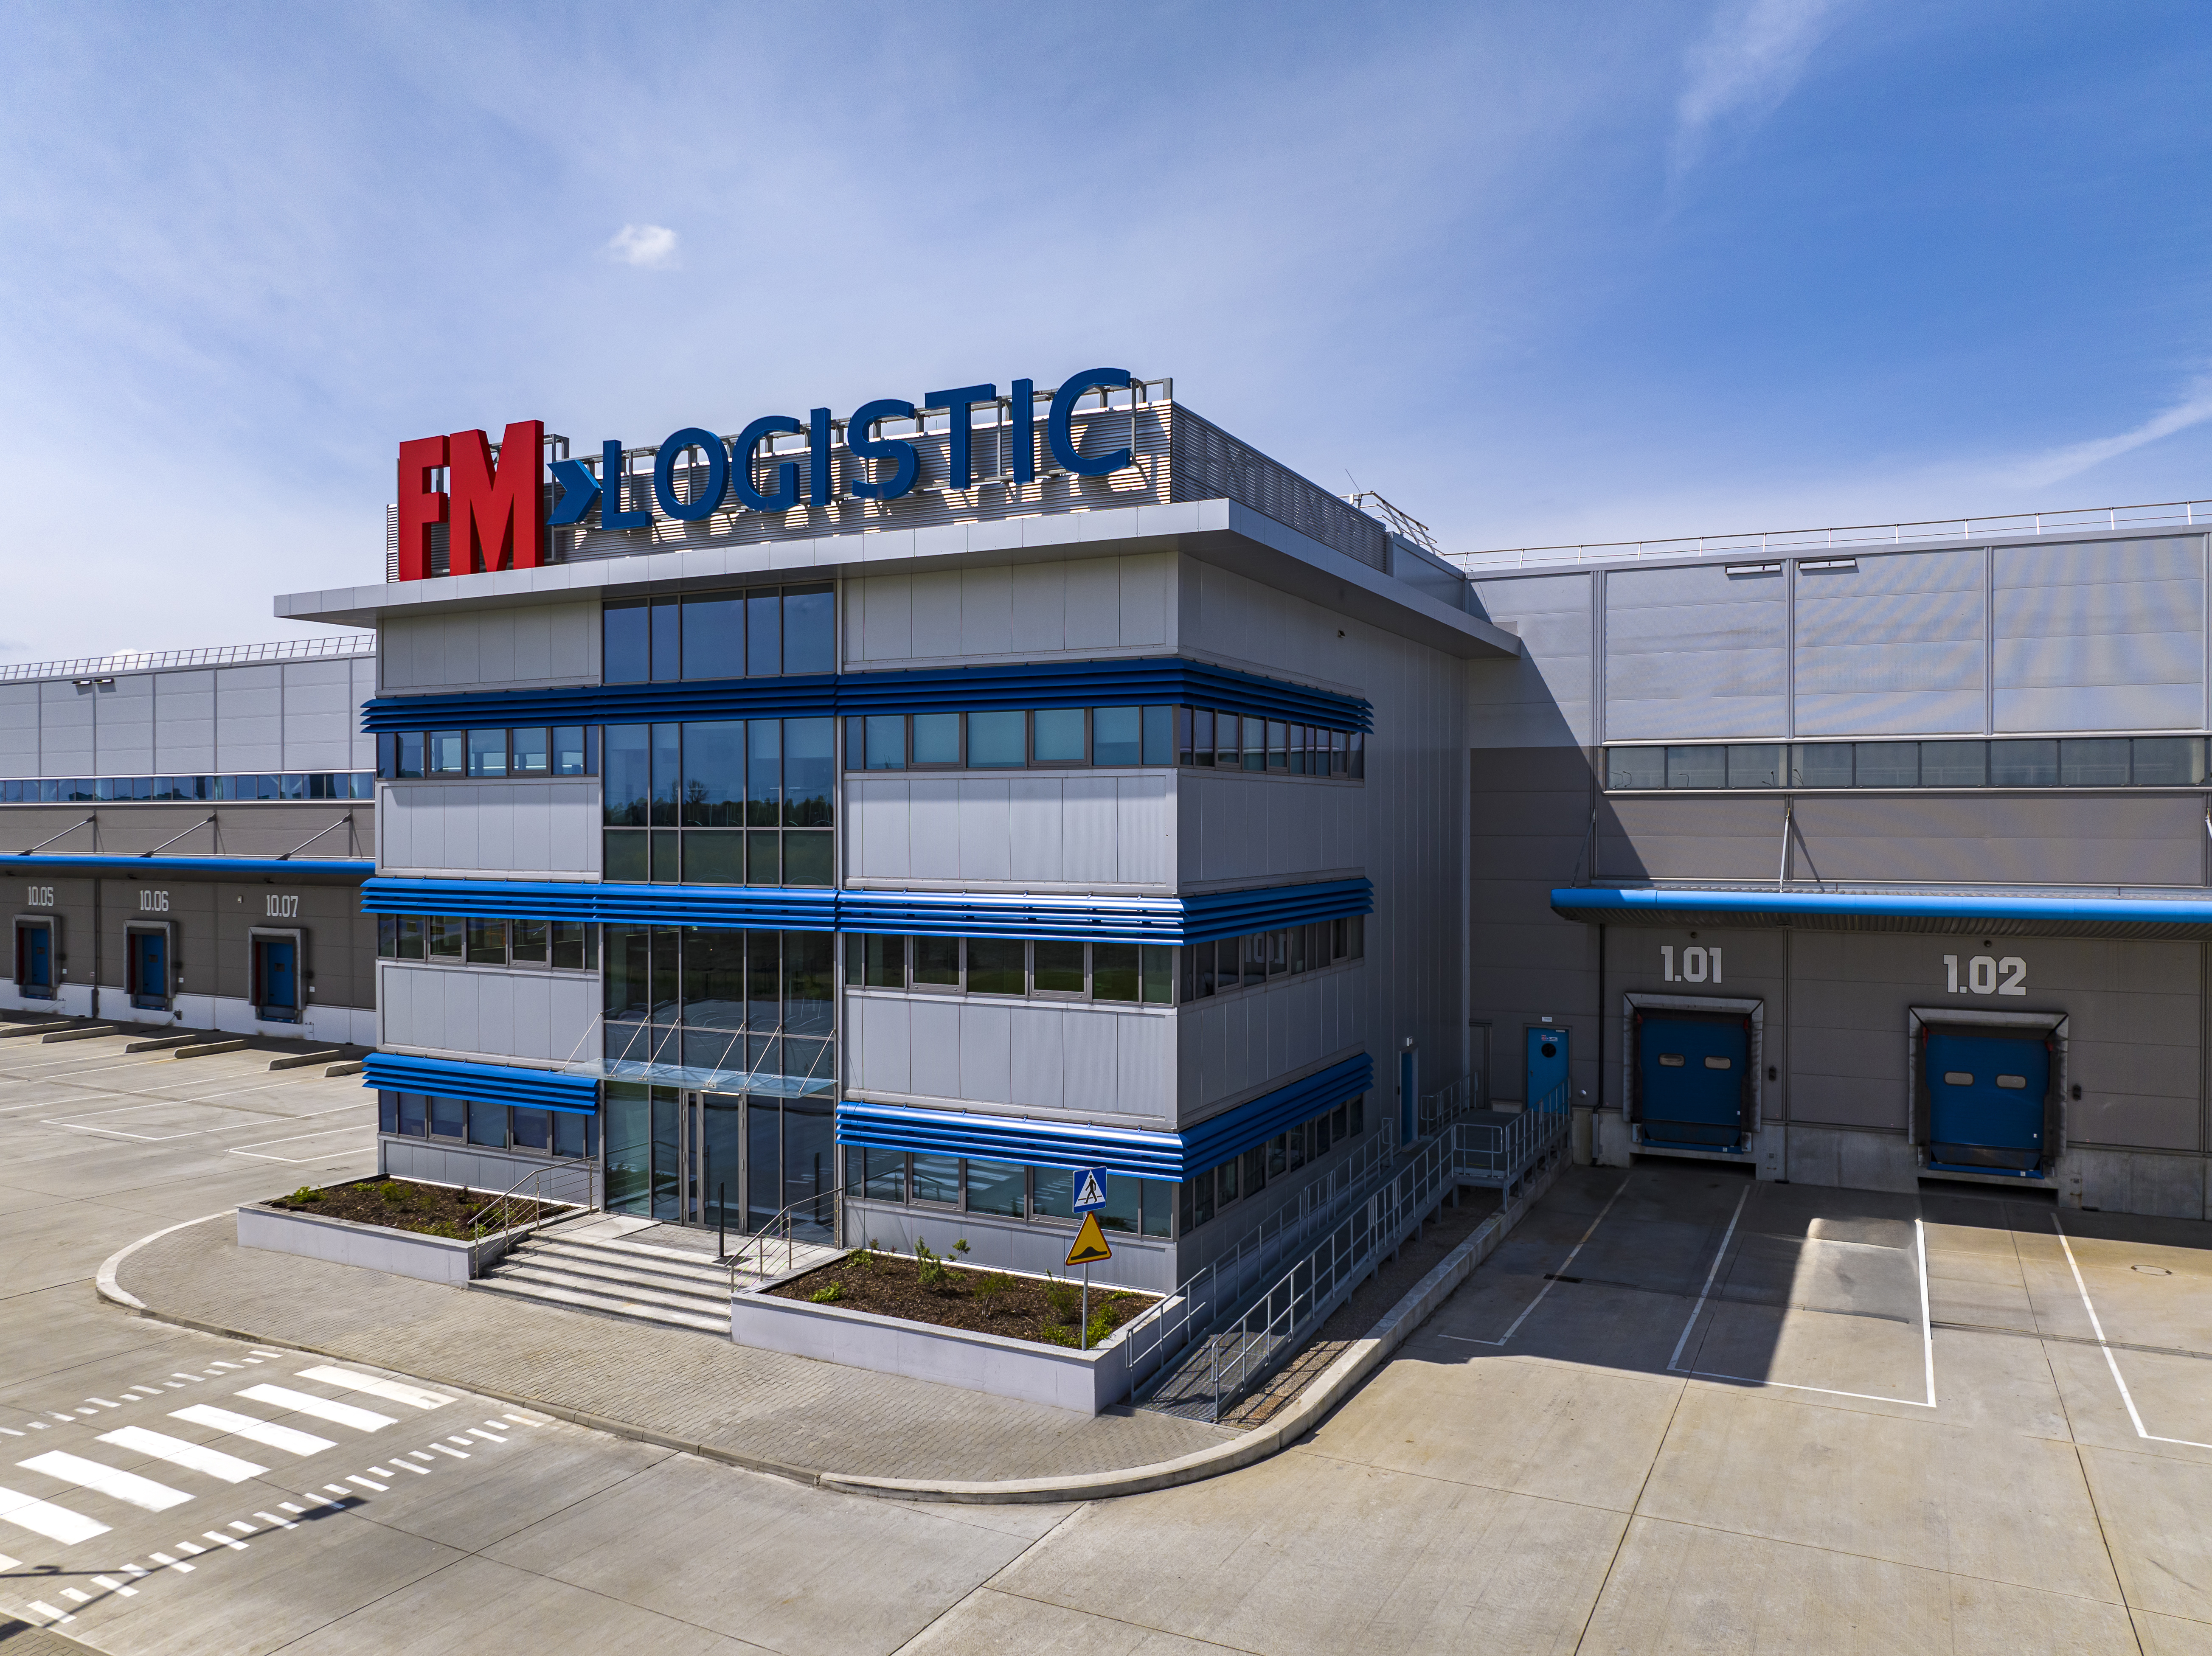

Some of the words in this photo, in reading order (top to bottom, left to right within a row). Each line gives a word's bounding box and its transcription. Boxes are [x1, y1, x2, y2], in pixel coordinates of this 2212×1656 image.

[400, 420, 544, 581] FM
[601, 368, 1131, 530] LOGISTIC
[28, 886, 53, 906] 10.05
[140, 890, 169, 912] 10.06
[267, 895, 298, 918] 10.07
[1661, 946, 1722, 983] 1.01
[1943, 955, 2026, 996] 1.02
